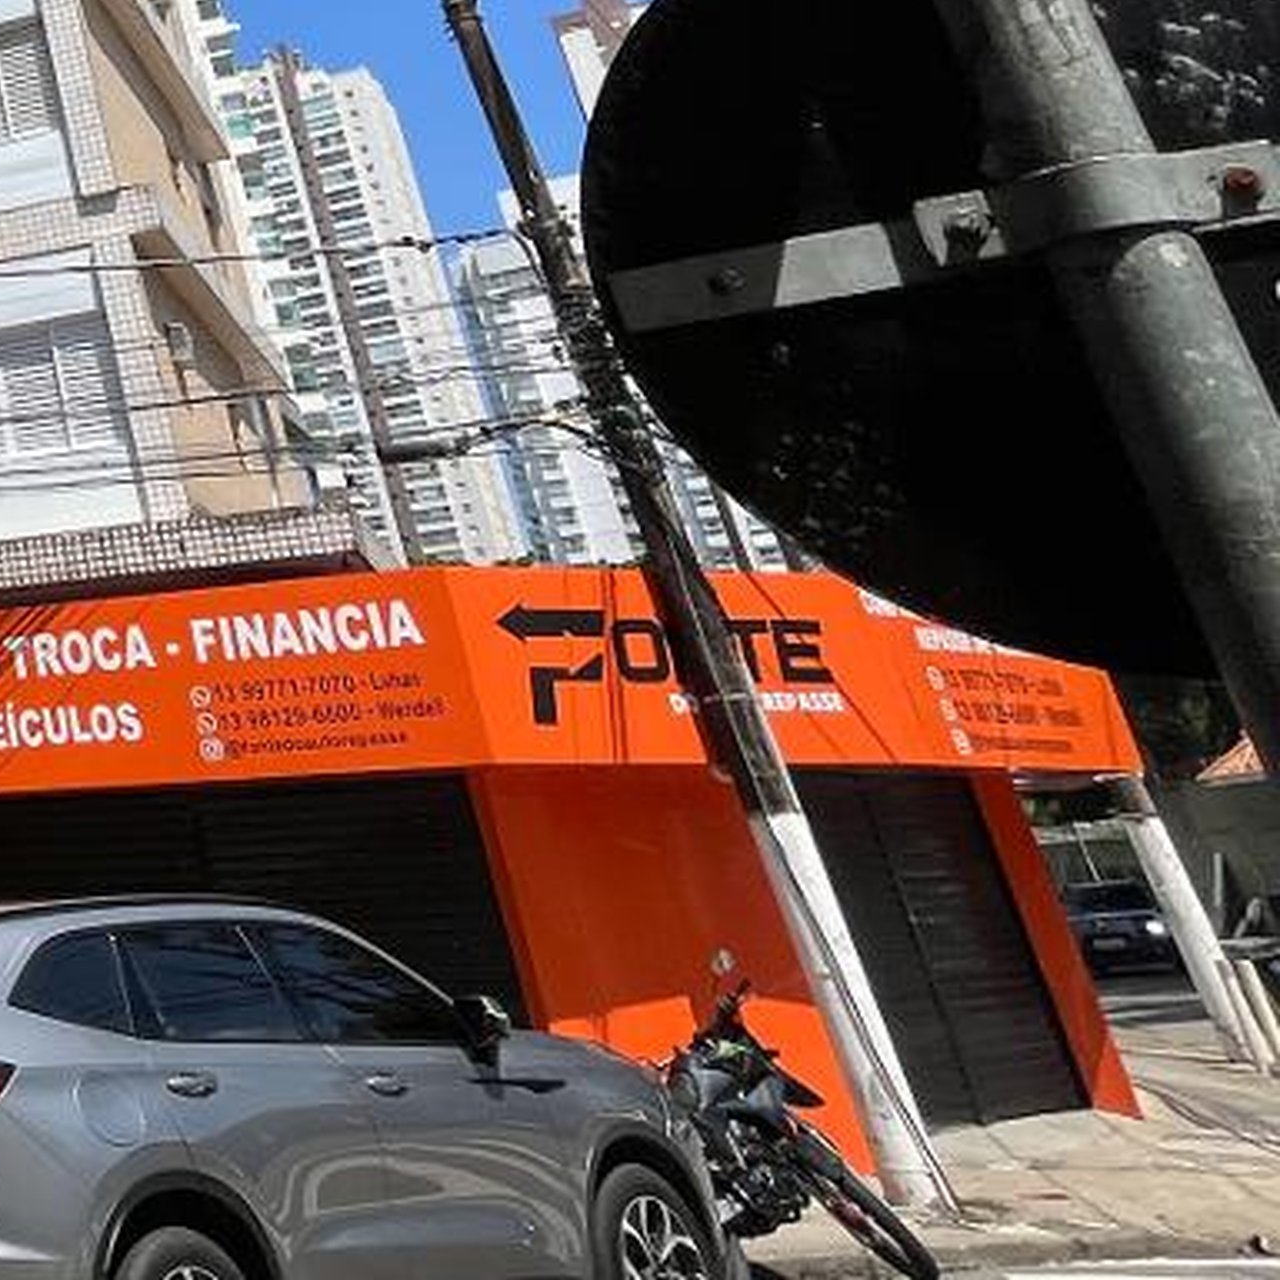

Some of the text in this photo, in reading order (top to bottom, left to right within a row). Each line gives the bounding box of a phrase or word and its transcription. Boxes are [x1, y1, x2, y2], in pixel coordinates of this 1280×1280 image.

[3, 623, 157, 680] TROCA
[189, 599, 425, 664] FINANCIA
[496, 603, 833, 724] FOTE
